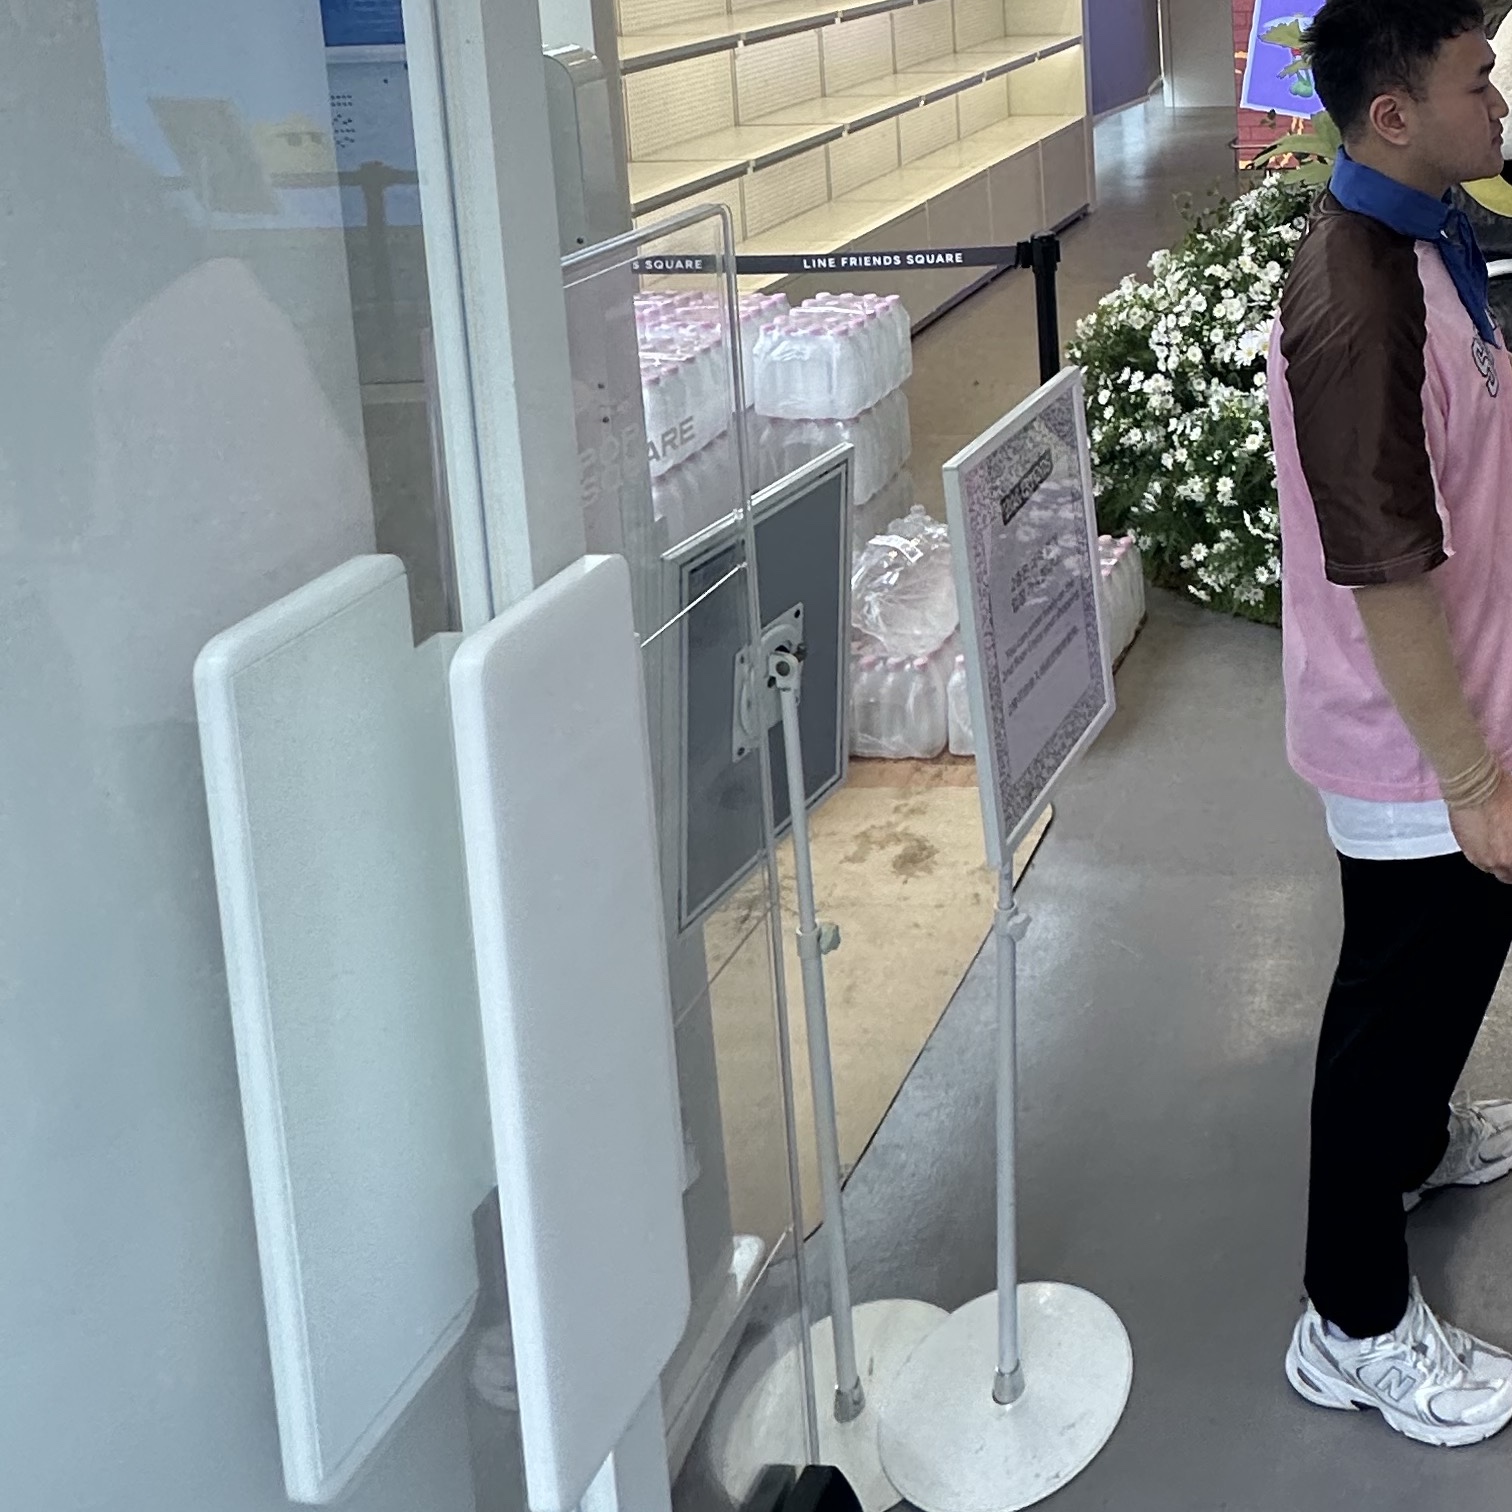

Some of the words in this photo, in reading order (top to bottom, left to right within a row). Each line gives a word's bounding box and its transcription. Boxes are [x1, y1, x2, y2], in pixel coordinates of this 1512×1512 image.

[645, 259, 702, 270] SQUARE
[803, 258, 836, 269] LINE
[841, 255, 901, 266] FRIENDS
[906, 253, 963, 264] SQUARE
